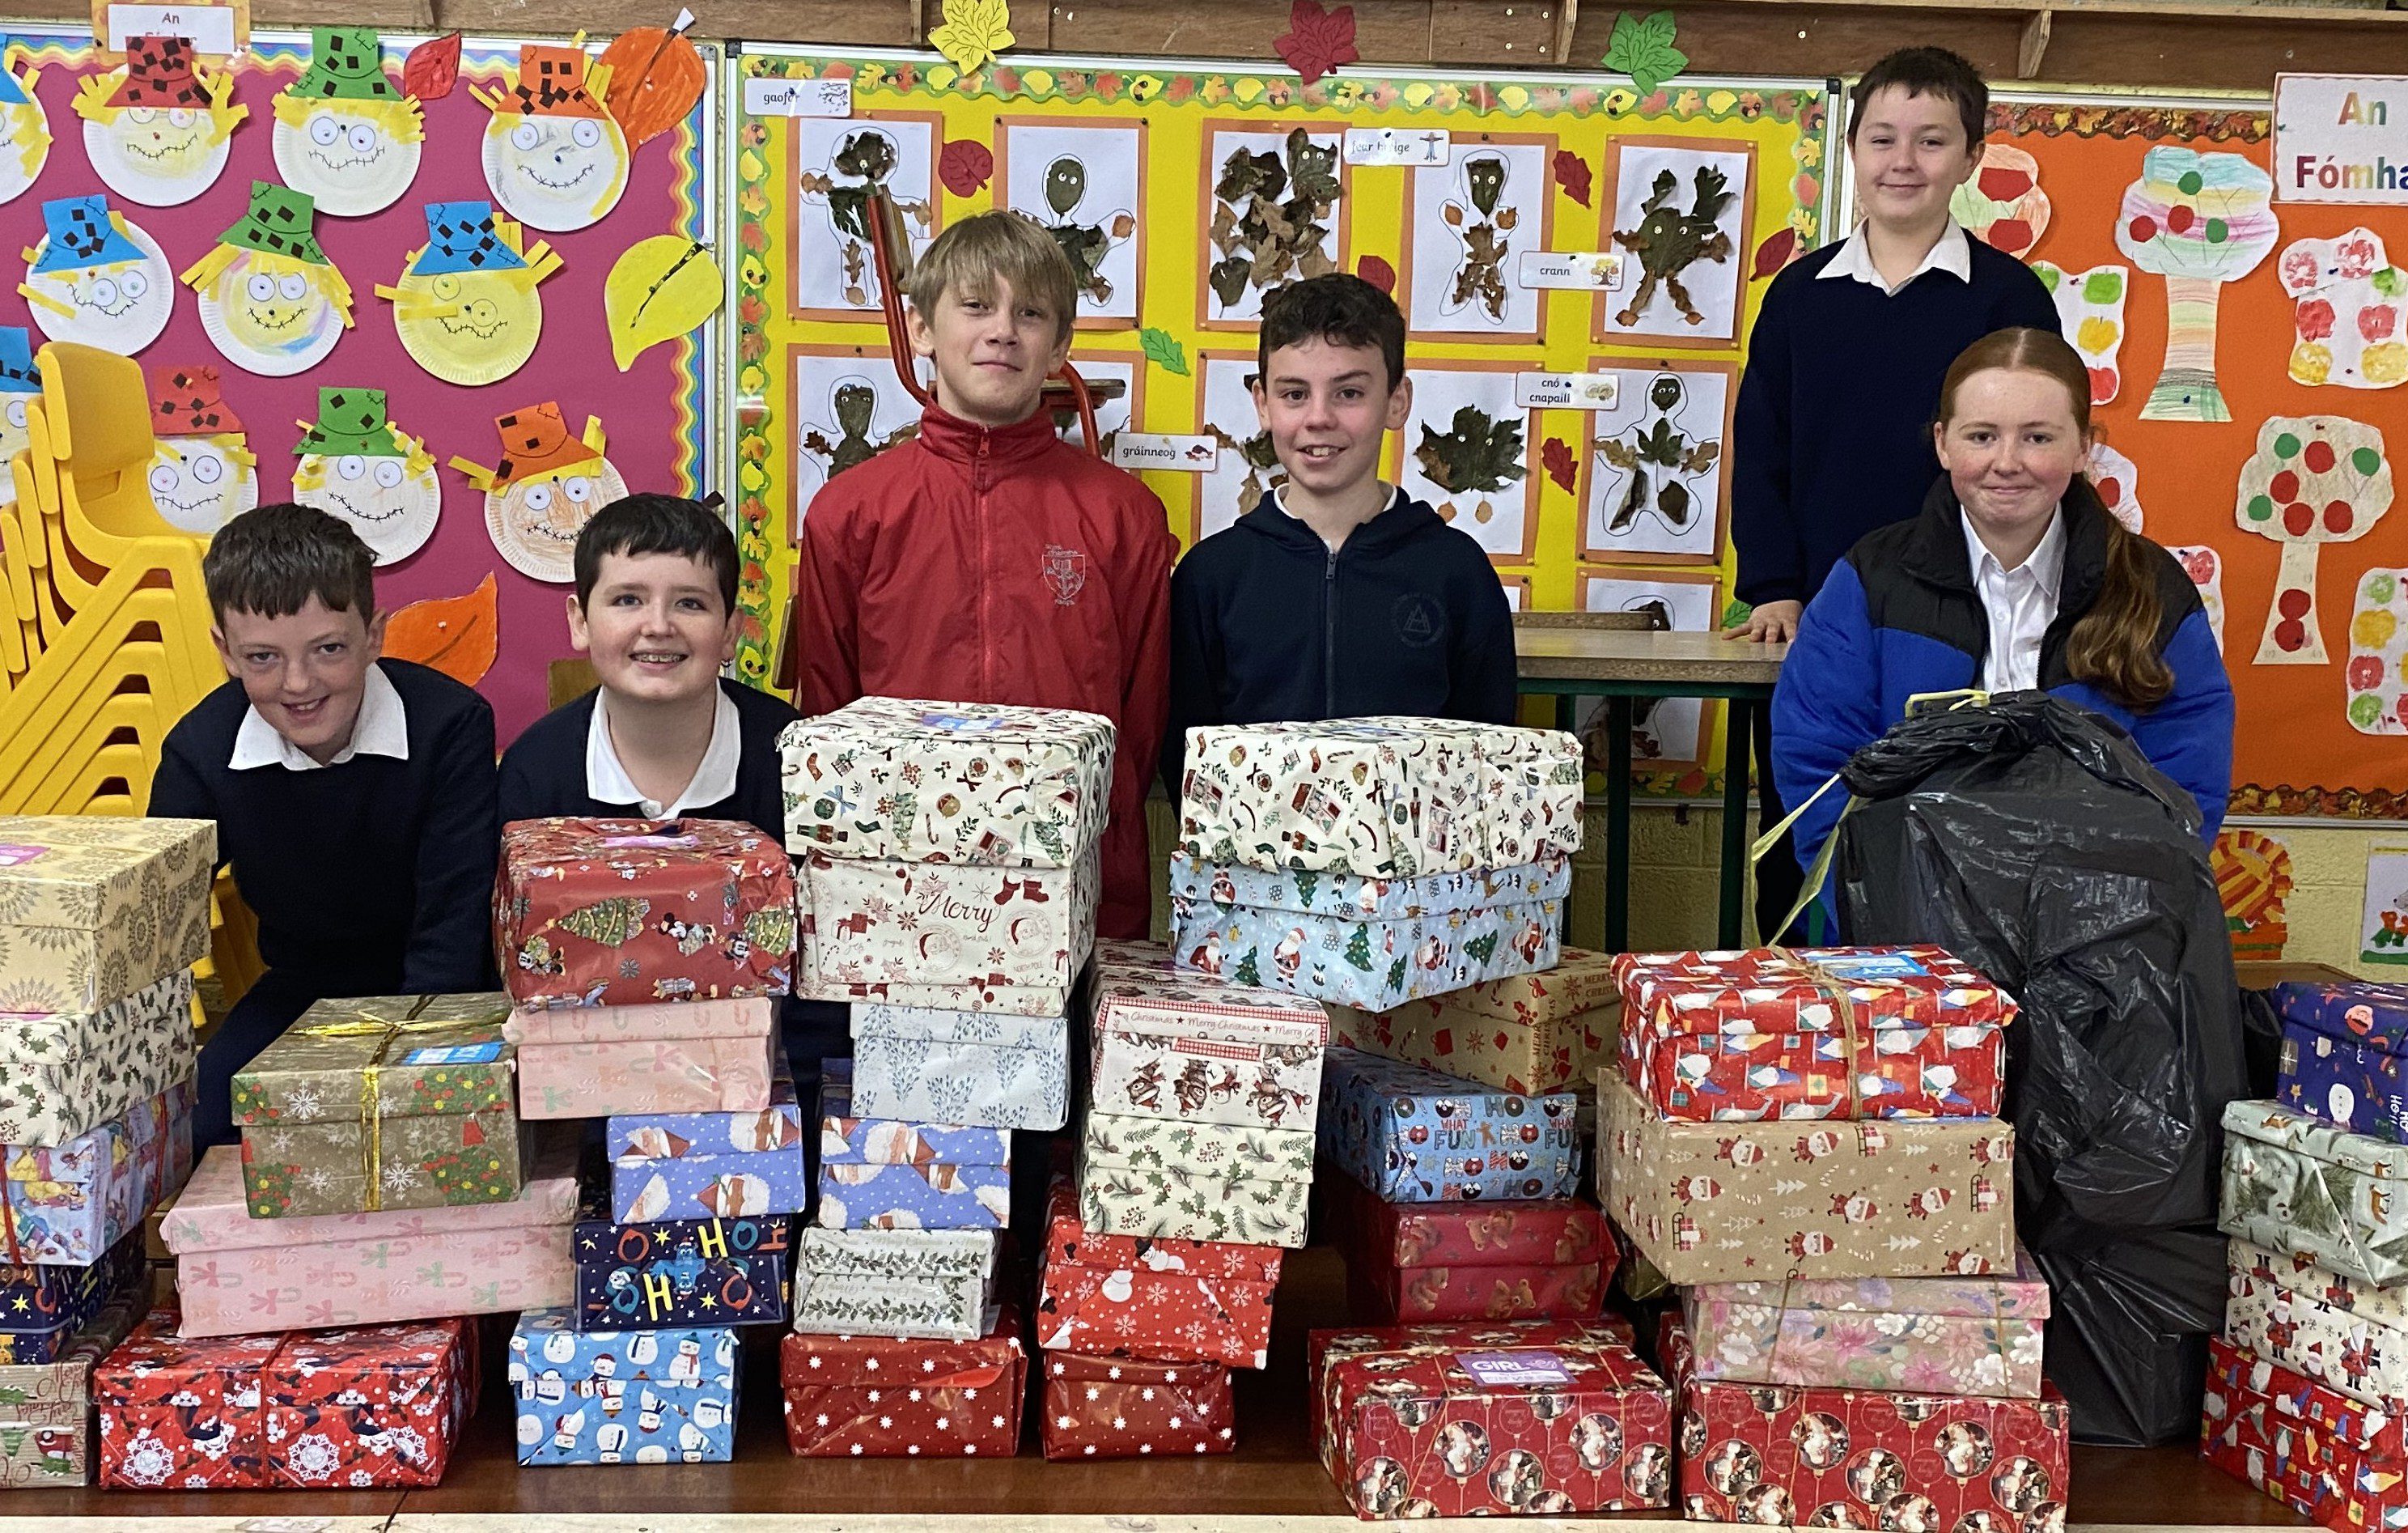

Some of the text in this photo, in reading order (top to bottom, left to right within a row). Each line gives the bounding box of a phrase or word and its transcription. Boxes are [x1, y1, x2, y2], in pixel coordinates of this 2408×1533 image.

[162, 12, 180, 24] An
[2338, 90, 2387, 125] An
[1540, 267, 1571, 276] crann
[1541, 378, 1560, 388] cnó
[1529, 393, 1571, 405] cnapaill
[1122, 446, 1176, 460] gráinneog
[918, 894, 1000, 932] Merry
[1435, 1129, 1476, 1150] FUN
[1471, 1361, 1530, 1371] GIRL
